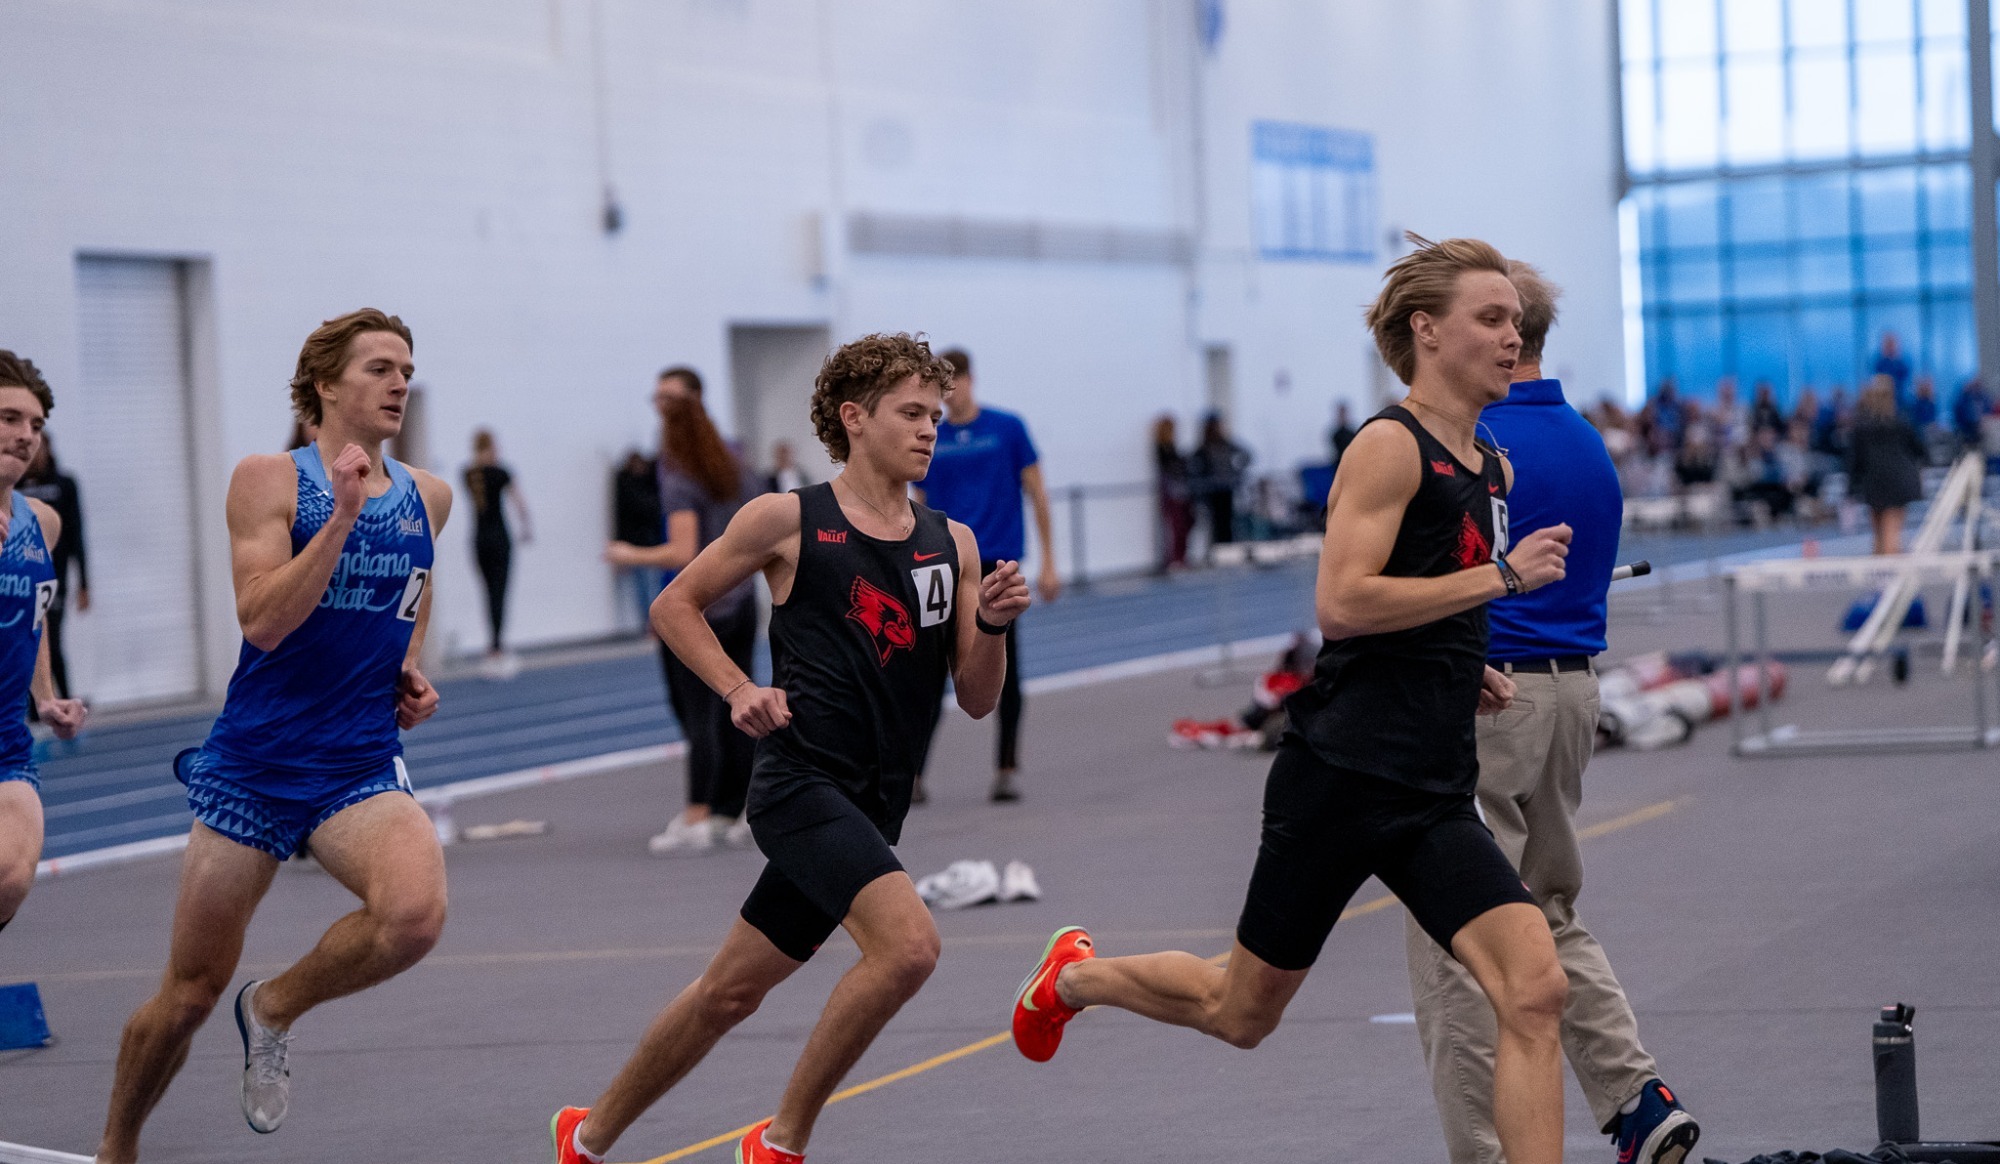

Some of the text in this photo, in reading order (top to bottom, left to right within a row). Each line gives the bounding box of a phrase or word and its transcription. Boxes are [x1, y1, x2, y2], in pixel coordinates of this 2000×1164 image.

[817, 528, 848, 544] VALLEY
[403, 570, 426, 619] 2
[926, 568, 948, 620] 4
